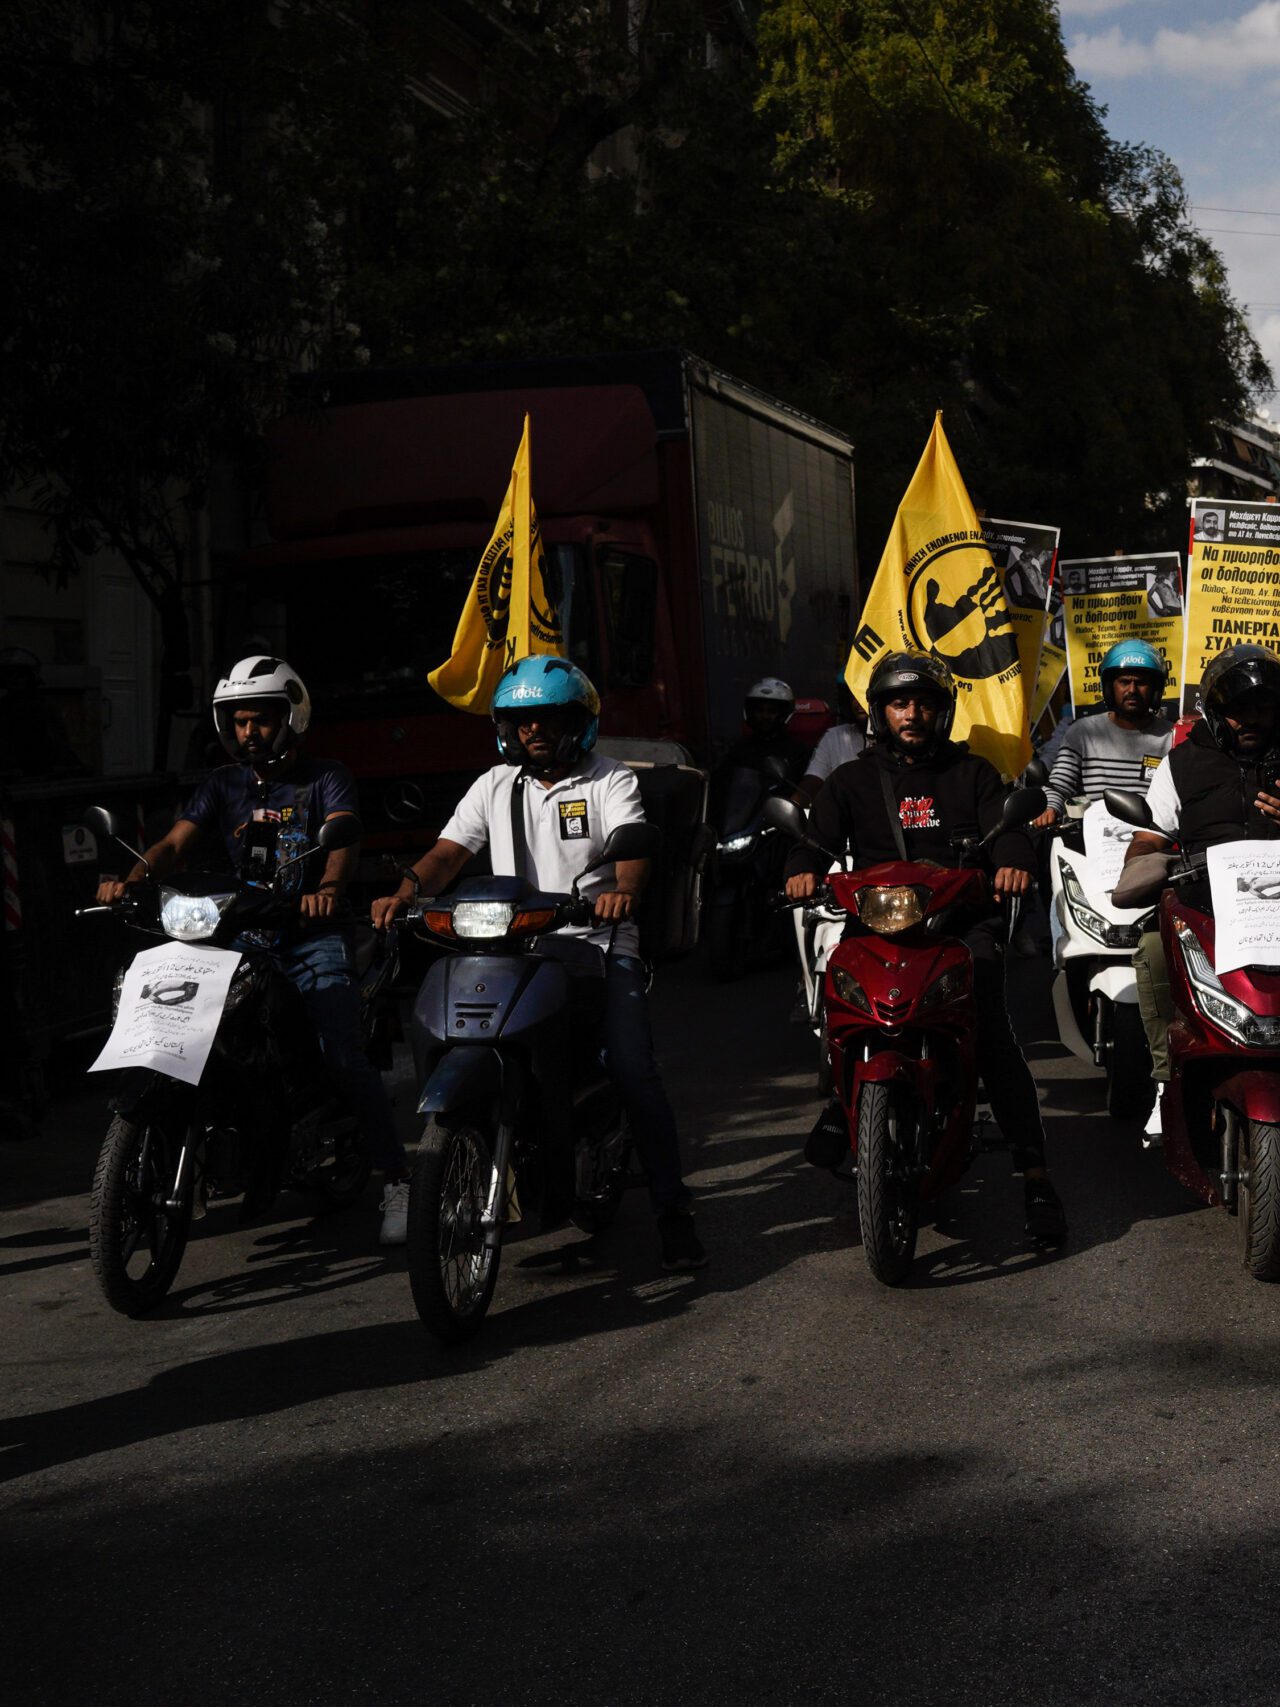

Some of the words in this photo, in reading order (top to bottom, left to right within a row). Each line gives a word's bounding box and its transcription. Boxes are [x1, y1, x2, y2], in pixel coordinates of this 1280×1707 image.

[1229, 511, 1261, 520] Μοχάμεντ
[708, 500, 744, 550] BILIOS
[903, 548, 927, 577] ΚΙΝΗΣΗ
[925, 531, 968, 553] ΕΝΩΜΕΝΟΙ
[1202, 546, 1218, 561] Να
[1201, 568, 1213, 580] οι
[710, 545, 775, 621] FERRO
[1202, 584, 1227, 594] Πύλος,
[1231, 587, 1255, 596] Τέμπη,
[1258, 588, 1270, 597] Αγ.
[1073, 597, 1085, 609] Να
[1088, 593, 1143, 608] τιμωρηθούν
[1074, 615, 1082, 624] οι
[1085, 609, 1137, 624] δολοφόνοι
[1212, 605, 1254, 615] κυβέρνηση
[1256, 608, 1270, 616] των
[1122, 655, 1145, 665] Wolt
[512, 686, 543, 700] Wolt
